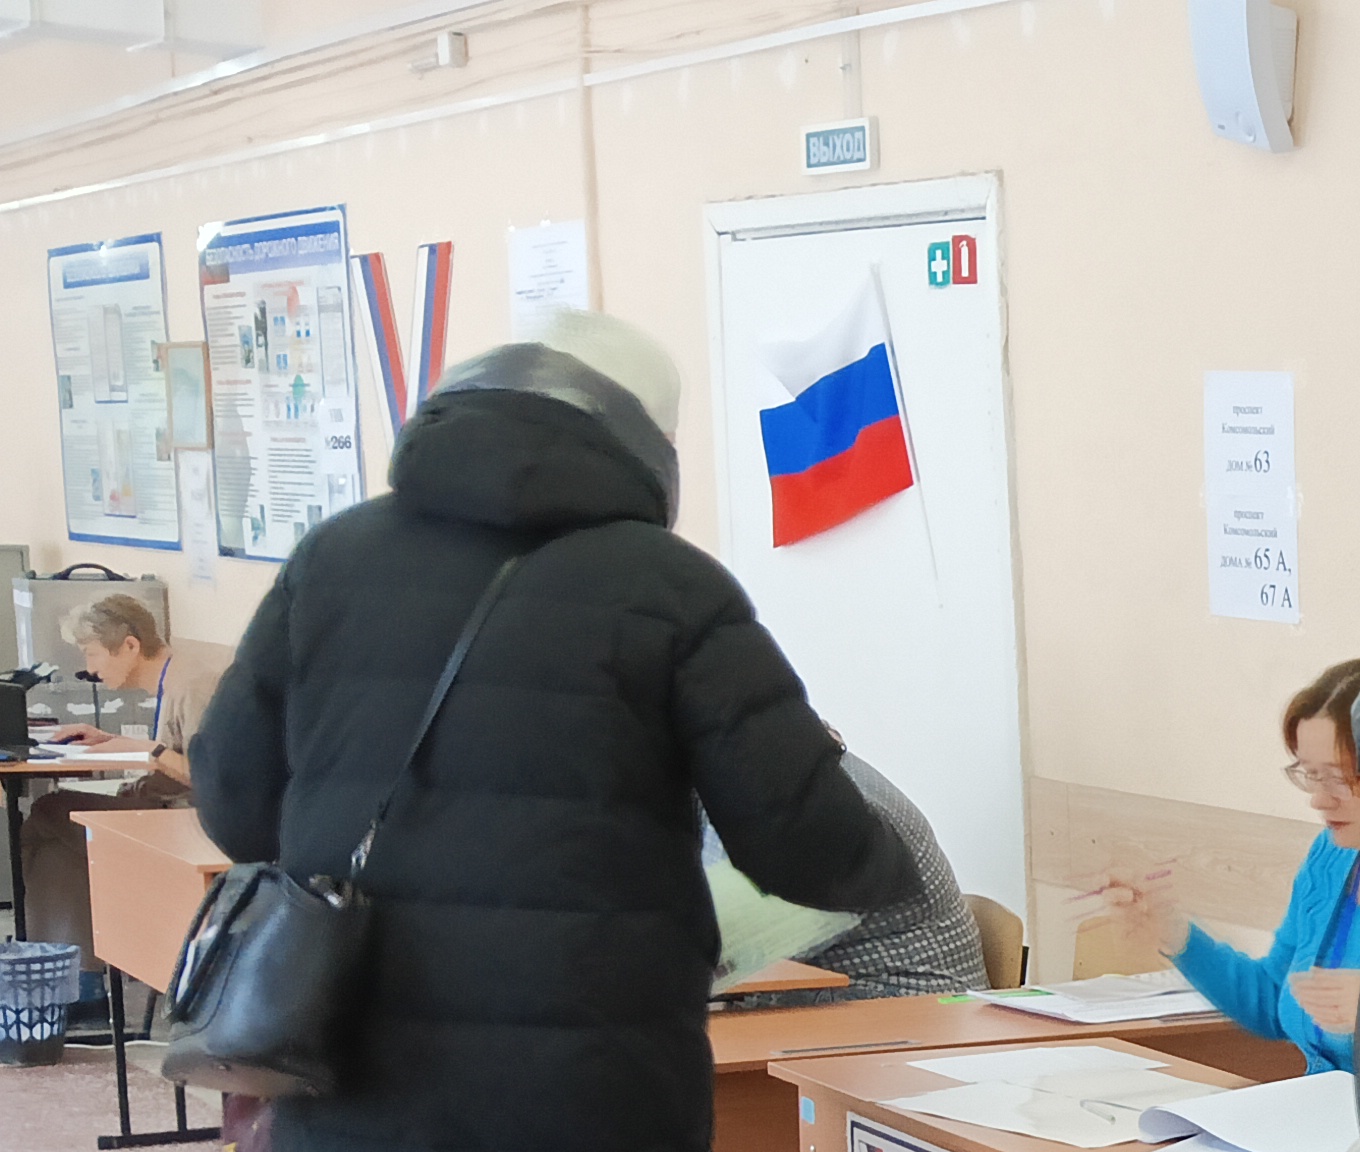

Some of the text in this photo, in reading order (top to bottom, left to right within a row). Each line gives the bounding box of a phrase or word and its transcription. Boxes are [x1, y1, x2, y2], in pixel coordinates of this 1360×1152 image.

[809, 131, 865, 164] ВЫХОД
[1254, 450, 1271, 473] 63
[1254, 547, 1271, 571] 65
[1276, 549, 1292, 576] А,
[1261, 584, 1292, 609] 67 А
